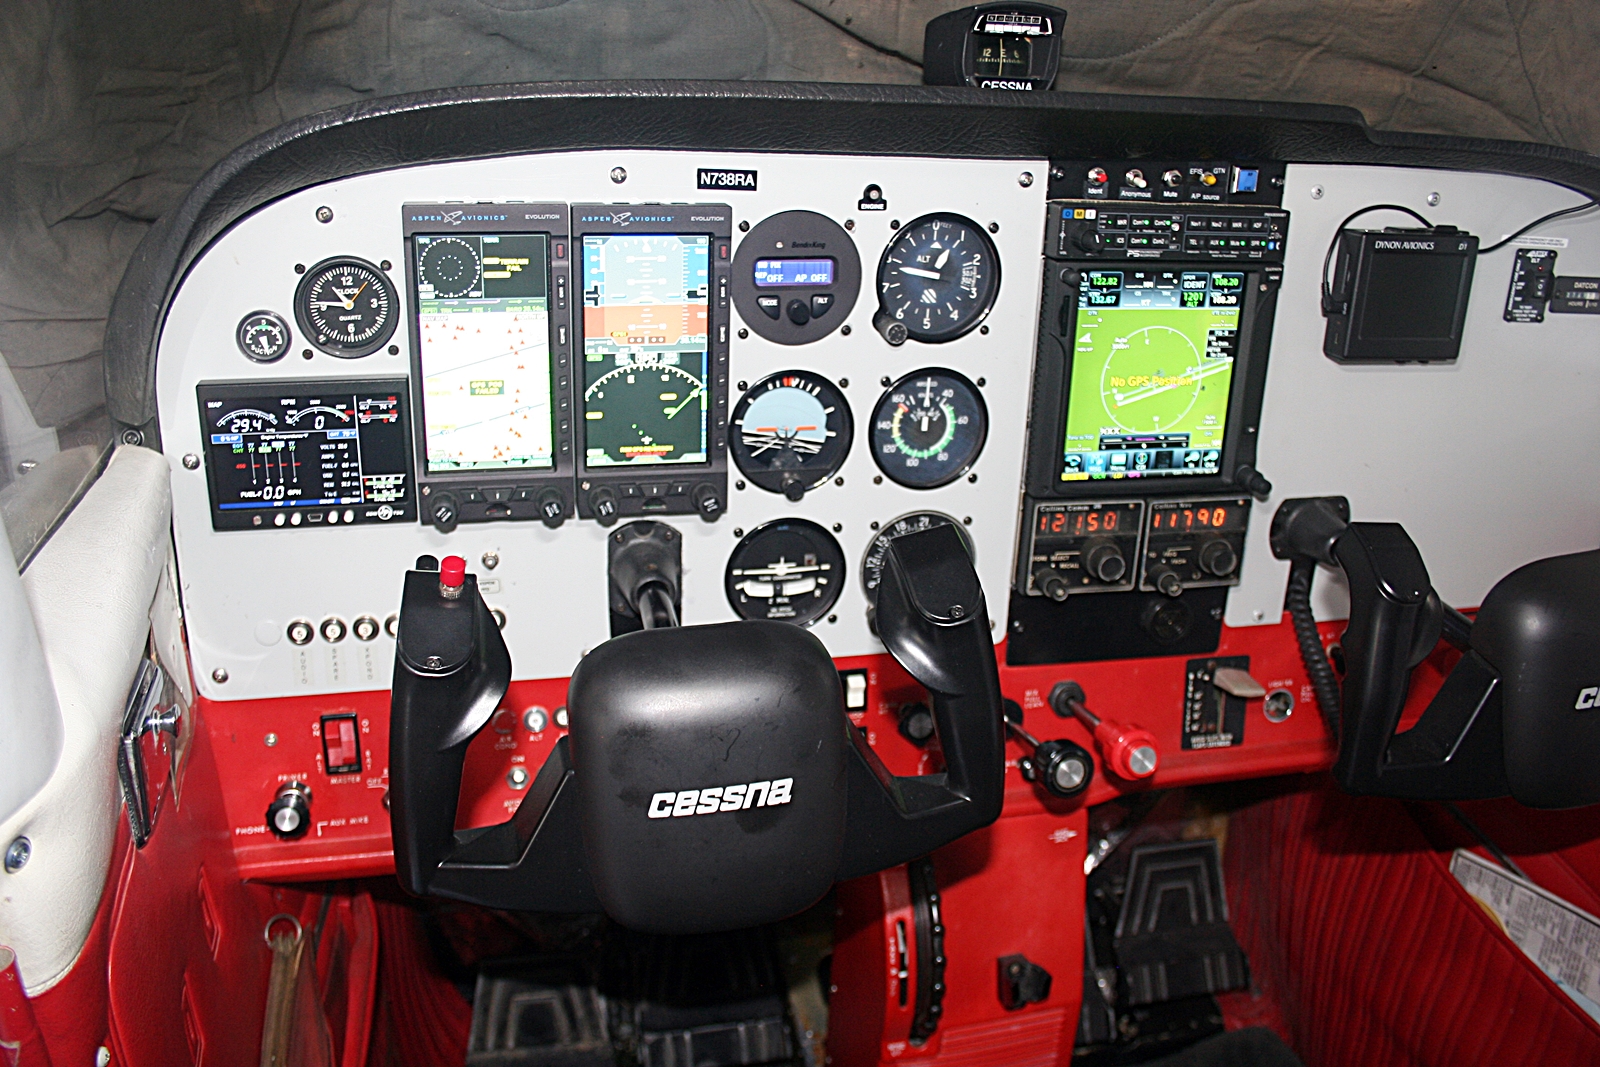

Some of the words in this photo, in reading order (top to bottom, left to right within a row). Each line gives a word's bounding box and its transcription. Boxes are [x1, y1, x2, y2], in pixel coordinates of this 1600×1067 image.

[983, 49, 992, 57] 12
[981, 81, 1032, 90] CESSNA
[700, 172, 755, 187] N738RA
[1087, 187, 1103, 195] Ident
[1121, 190, 1152, 198] Anonymous
[932, 220, 940, 230] 0
[1375, 241, 1402, 249] DYNON
[1402, 241, 1435, 250] AVIONICS
[916, 255, 931, 263] ALT
[973, 254, 981, 265] 2
[340, 276, 354, 286] 12
[767, 274, 784, 282] OFF
[795, 274, 807, 282] AP
[811, 274, 827, 282] OFF
[882, 283, 890, 293] 7
[1183, 281, 1206, 289] IDENT
[969, 288, 978, 298] 3
[1183, 292, 1204, 301] 1201
[370, 299, 378, 308] 3
[895, 308, 904, 319] 6
[950, 310, 959, 320] 4
[347, 323, 355, 333] 6
[923, 319, 931, 329] 5
[1110, 377, 1126, 387] No
[1127, 376, 1150, 387] GPS
[1151, 376, 1193, 387] Position
[942, 389, 954, 397] 40
[892, 394, 905, 403] 160
[314, 415, 325, 430] 0
[957, 416, 968, 424] 60
[231, 418, 263, 433] 29.4
[877, 421, 891, 429] 140
[883, 444, 896, 453] 120
[937, 452, 948, 461] 80
[906, 459, 919, 467] 100
[263, 485, 285, 500] 0.0
[814, 589, 821, 597] R
[741, 594, 747, 602] L
[300, 650, 308, 685] AUDIO
[529, 733, 543, 742] ALT
[511, 755, 525, 763] ON
[278, 773, 307, 782] PRIMER
[330, 776, 361, 785] MASTER
[330, 819, 346, 827] AUX
[235, 827, 266, 836] PHONE
